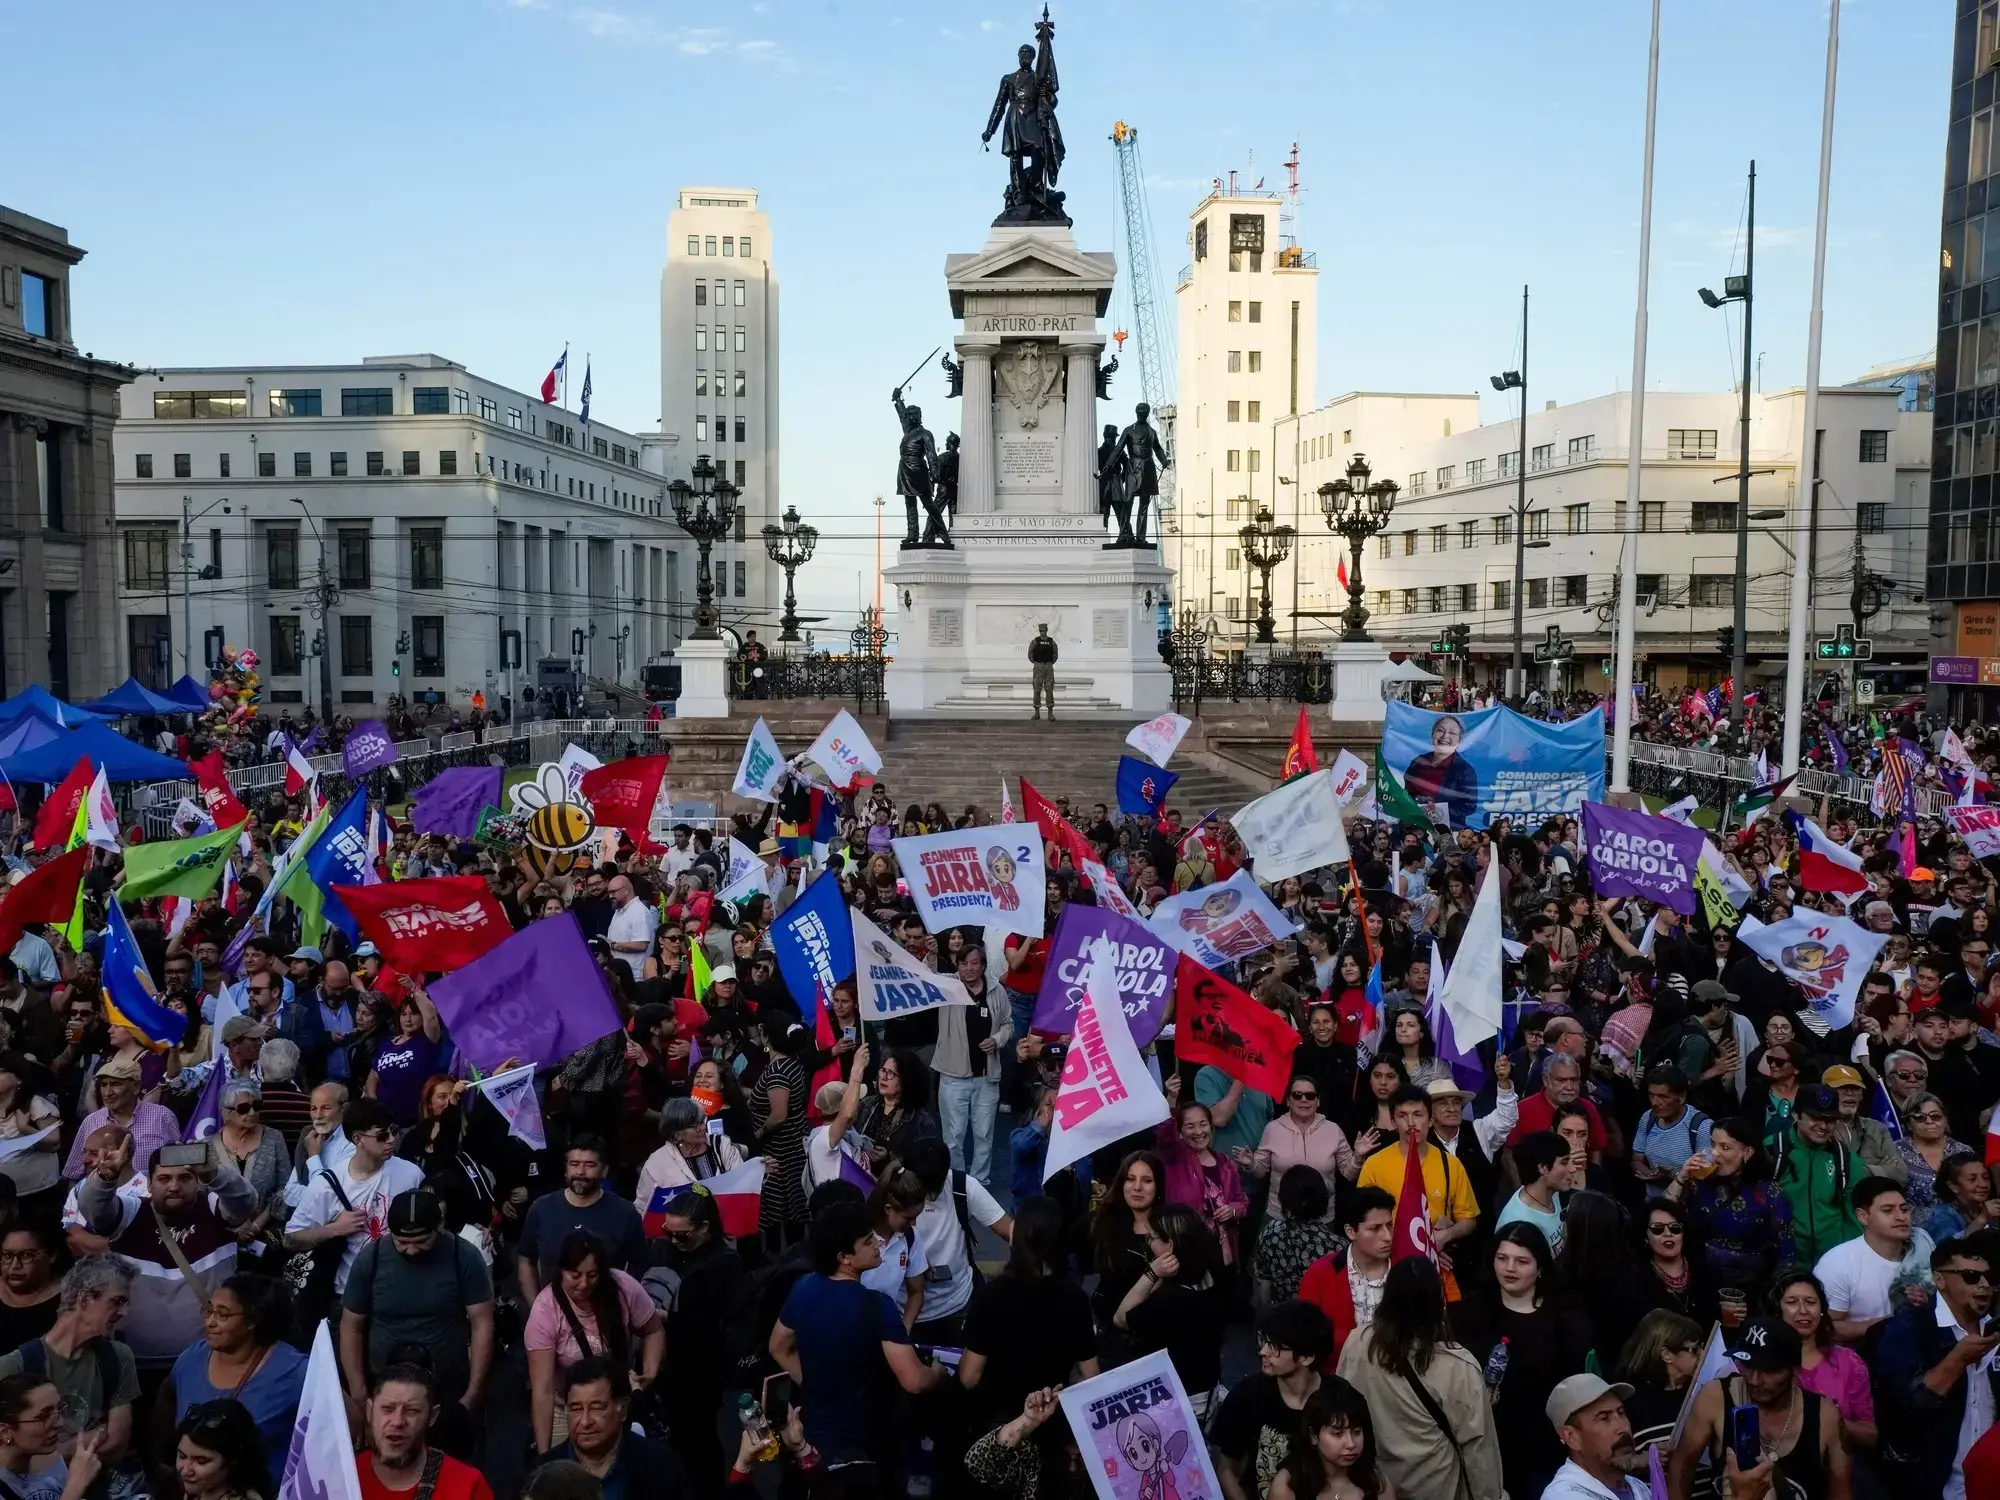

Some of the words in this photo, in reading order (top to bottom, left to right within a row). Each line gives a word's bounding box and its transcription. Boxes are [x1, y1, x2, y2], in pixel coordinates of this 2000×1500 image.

[983, 318, 1036, 331] ARTURO
[1043, 317, 1077, 331] PRAT
[984, 518, 995, 527] 21
[1000, 518, 1012, 527] DE
[1019, 518, 1045, 527] MAYO
[1051, 518, 1072, 527] 1879
[972, 537, 991, 545] SUS
[997, 537, 1037, 545] HEROES
[1964, 616, 1983, 624] Giros
[1985, 616, 1996, 624] de
[1966, 627, 1992, 635] Dinero
[1950, 664, 1974, 673] INTER
[1862, 683, 1869, 692] E
[346, 732, 378, 751] AROL
[347, 738, 387, 762] RIOLA
[1496, 771, 1560, 780] COMANDO
[1482, 790, 1589, 812] JARA
[1016, 845, 1031, 863] 2
[1599, 828, 1678, 861] KAROL
[326, 844, 362, 882] SENA
[919, 846, 979, 866] JEANNETTE
[1591, 844, 1688, 883] CARIOLA
[924, 861, 990, 898] JARA
[931, 894, 993, 911] PRESIDENTA
[806, 909, 830, 950] DIEGO
[873, 981, 947, 1012] JARA
[690, 1095, 713, 1106] SHARP
[1745, 1324, 1768, 1347] NY
[1089, 1376, 1164, 1412] JEANNETTE
[1091, 1384, 1174, 1430] JARA
